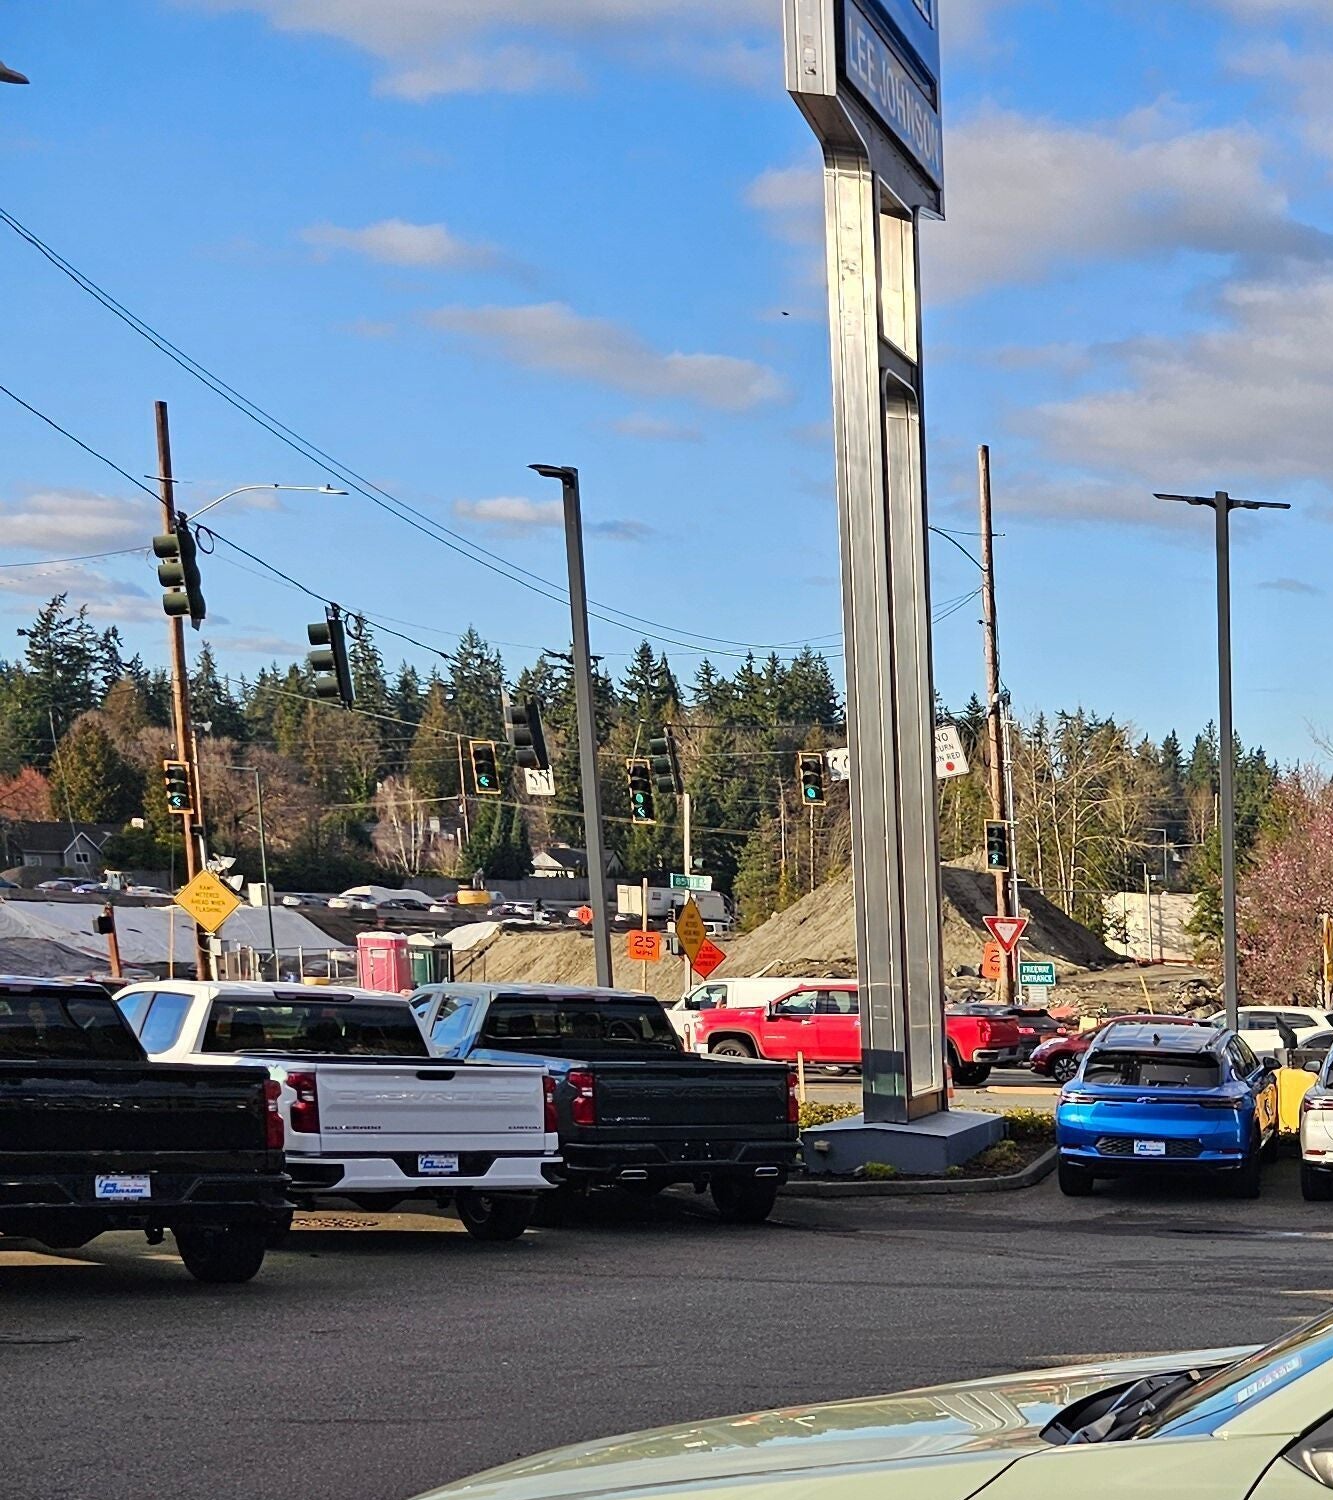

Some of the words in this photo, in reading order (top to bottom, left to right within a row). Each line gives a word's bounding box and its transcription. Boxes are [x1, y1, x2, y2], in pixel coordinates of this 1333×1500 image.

[849, 16, 876, 92] LEE
[880, 60, 939, 171] JOHNSON
[935, 733, 948, 742] NO
[634, 936, 655, 948] 25
